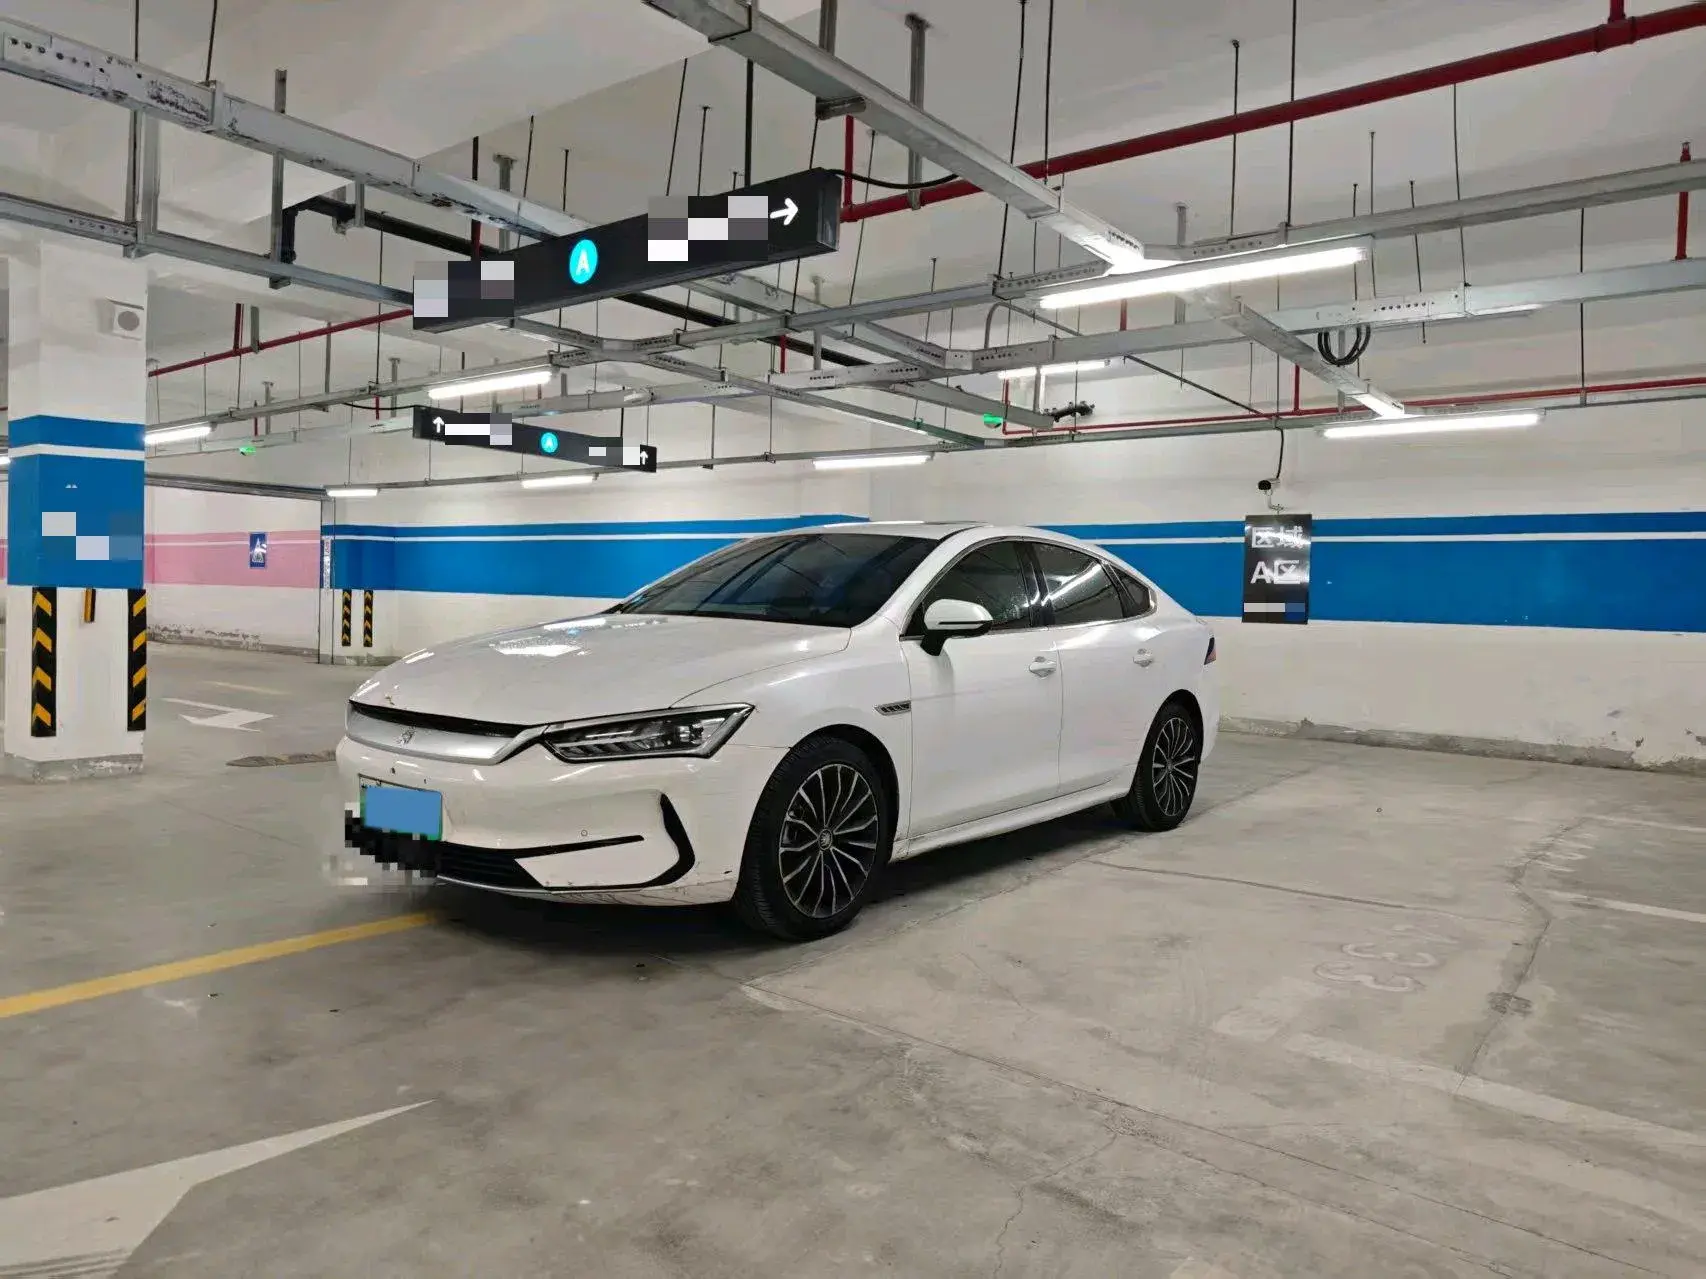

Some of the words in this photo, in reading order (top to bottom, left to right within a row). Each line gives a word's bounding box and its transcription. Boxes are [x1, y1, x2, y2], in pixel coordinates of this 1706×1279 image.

[575, 249, 591, 276] A
[1252, 525, 1304, 549] 区域
[1250, 559, 1301, 585] A区
